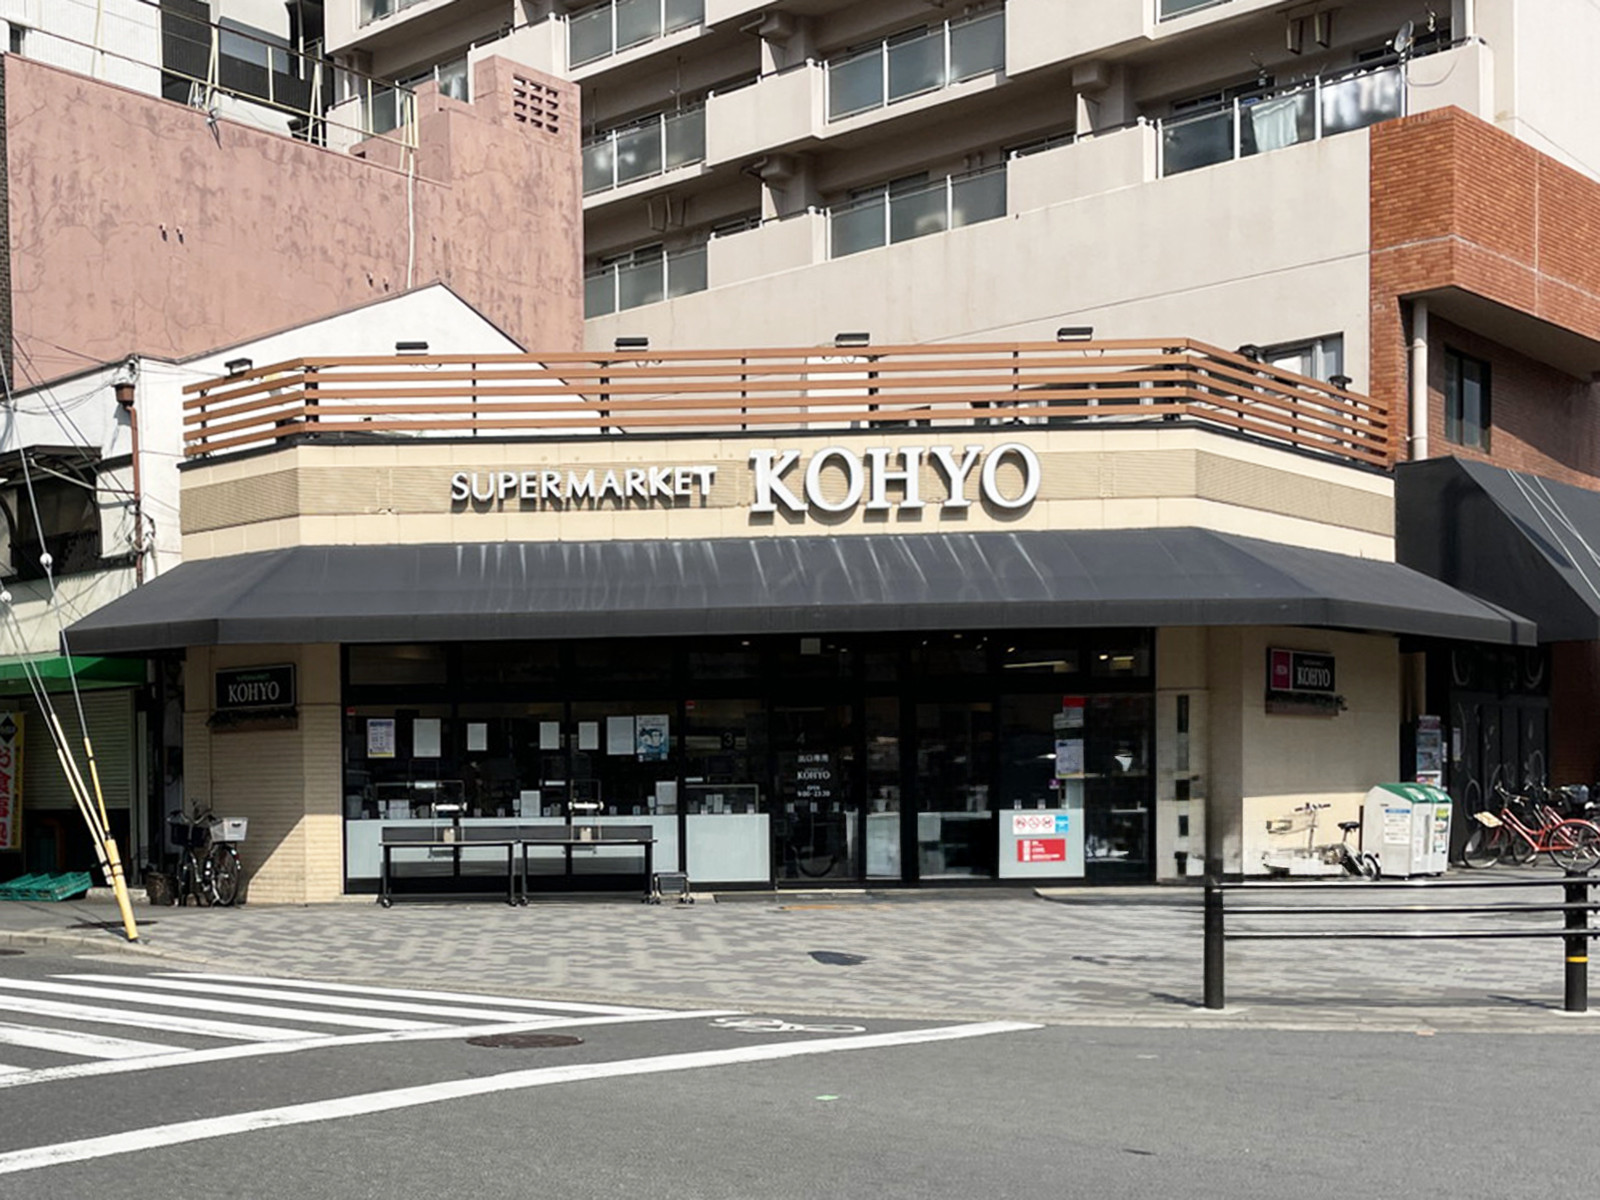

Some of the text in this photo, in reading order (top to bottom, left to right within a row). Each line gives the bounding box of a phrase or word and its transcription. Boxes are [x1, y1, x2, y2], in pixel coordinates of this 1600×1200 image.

[451, 442, 1040, 511] SUPERMARKET KOHYO
[228, 681, 280, 703] KOHYO
